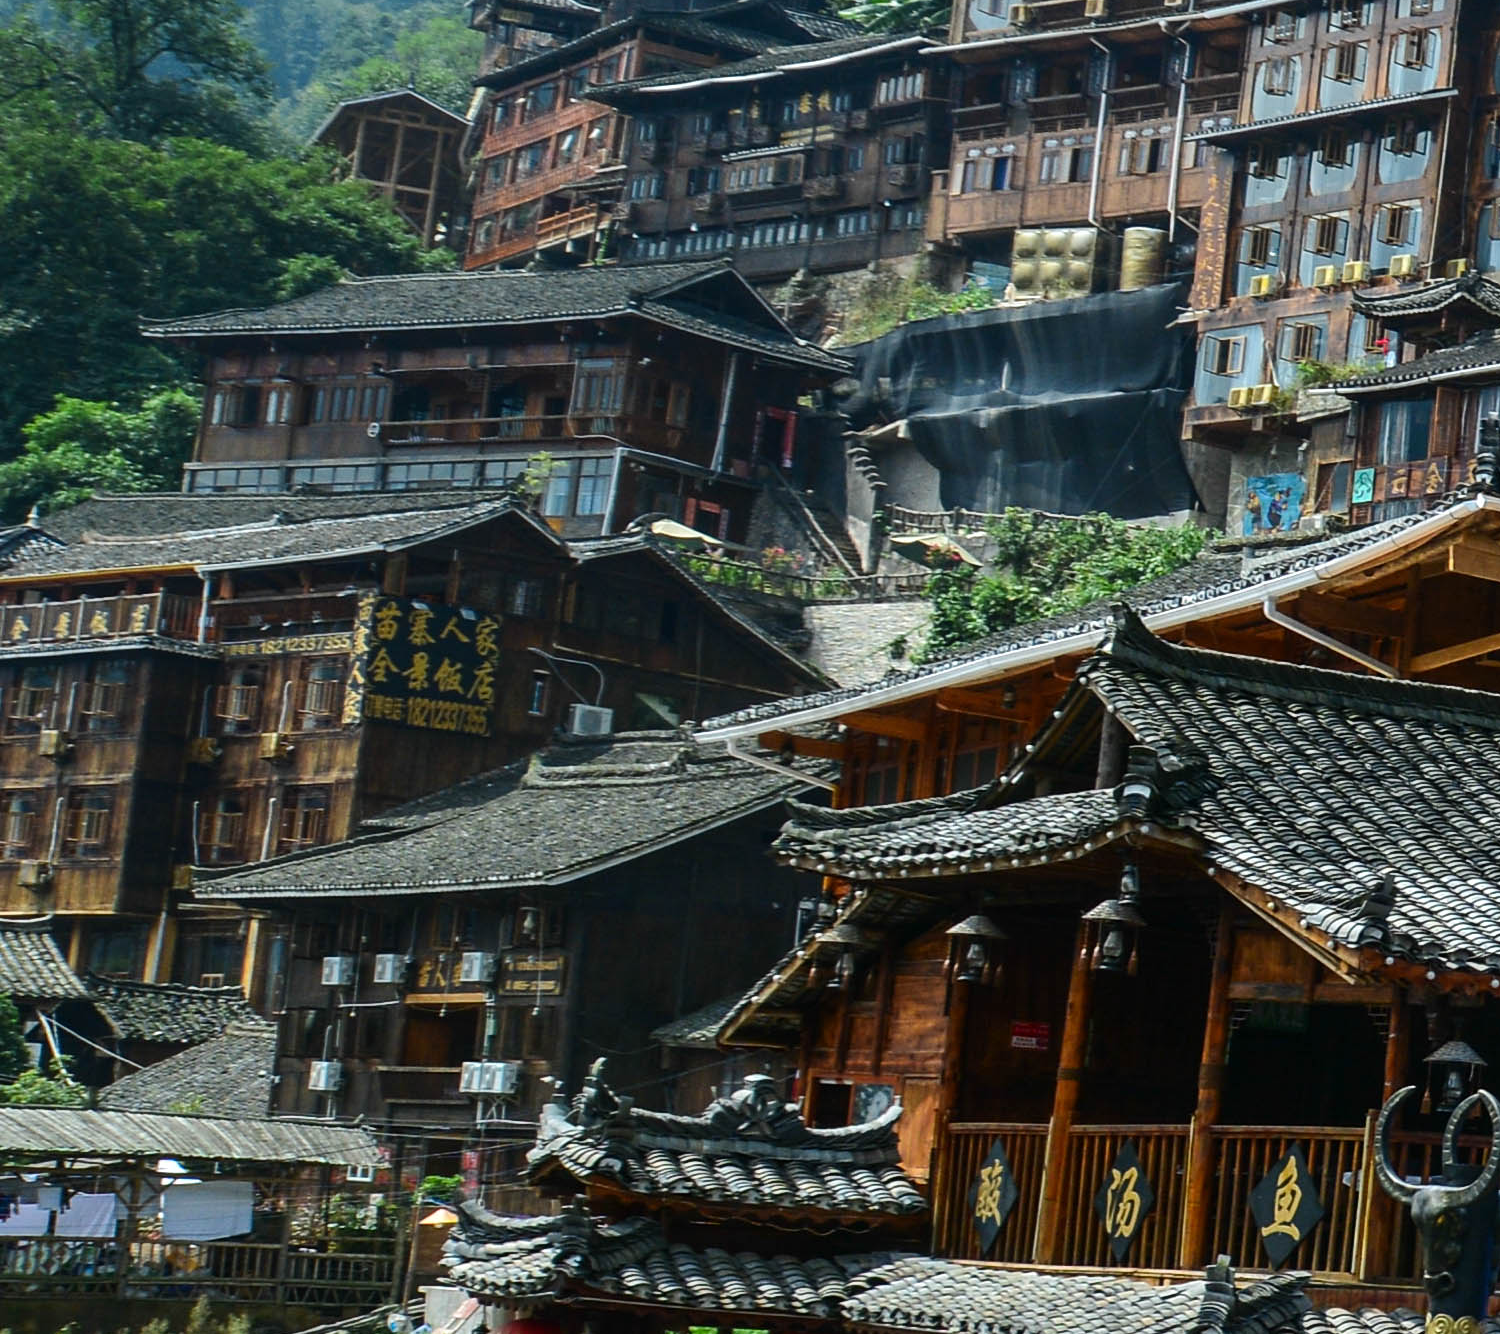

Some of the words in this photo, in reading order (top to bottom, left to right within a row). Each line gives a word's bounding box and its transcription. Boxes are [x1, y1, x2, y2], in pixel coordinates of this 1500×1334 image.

[376, 602, 499, 657] 苗寨人家
[368, 648, 496, 704] 全景饭店
[1105, 1167, 1141, 1238] 汤
[1261, 1155, 1303, 1242] 鱼
